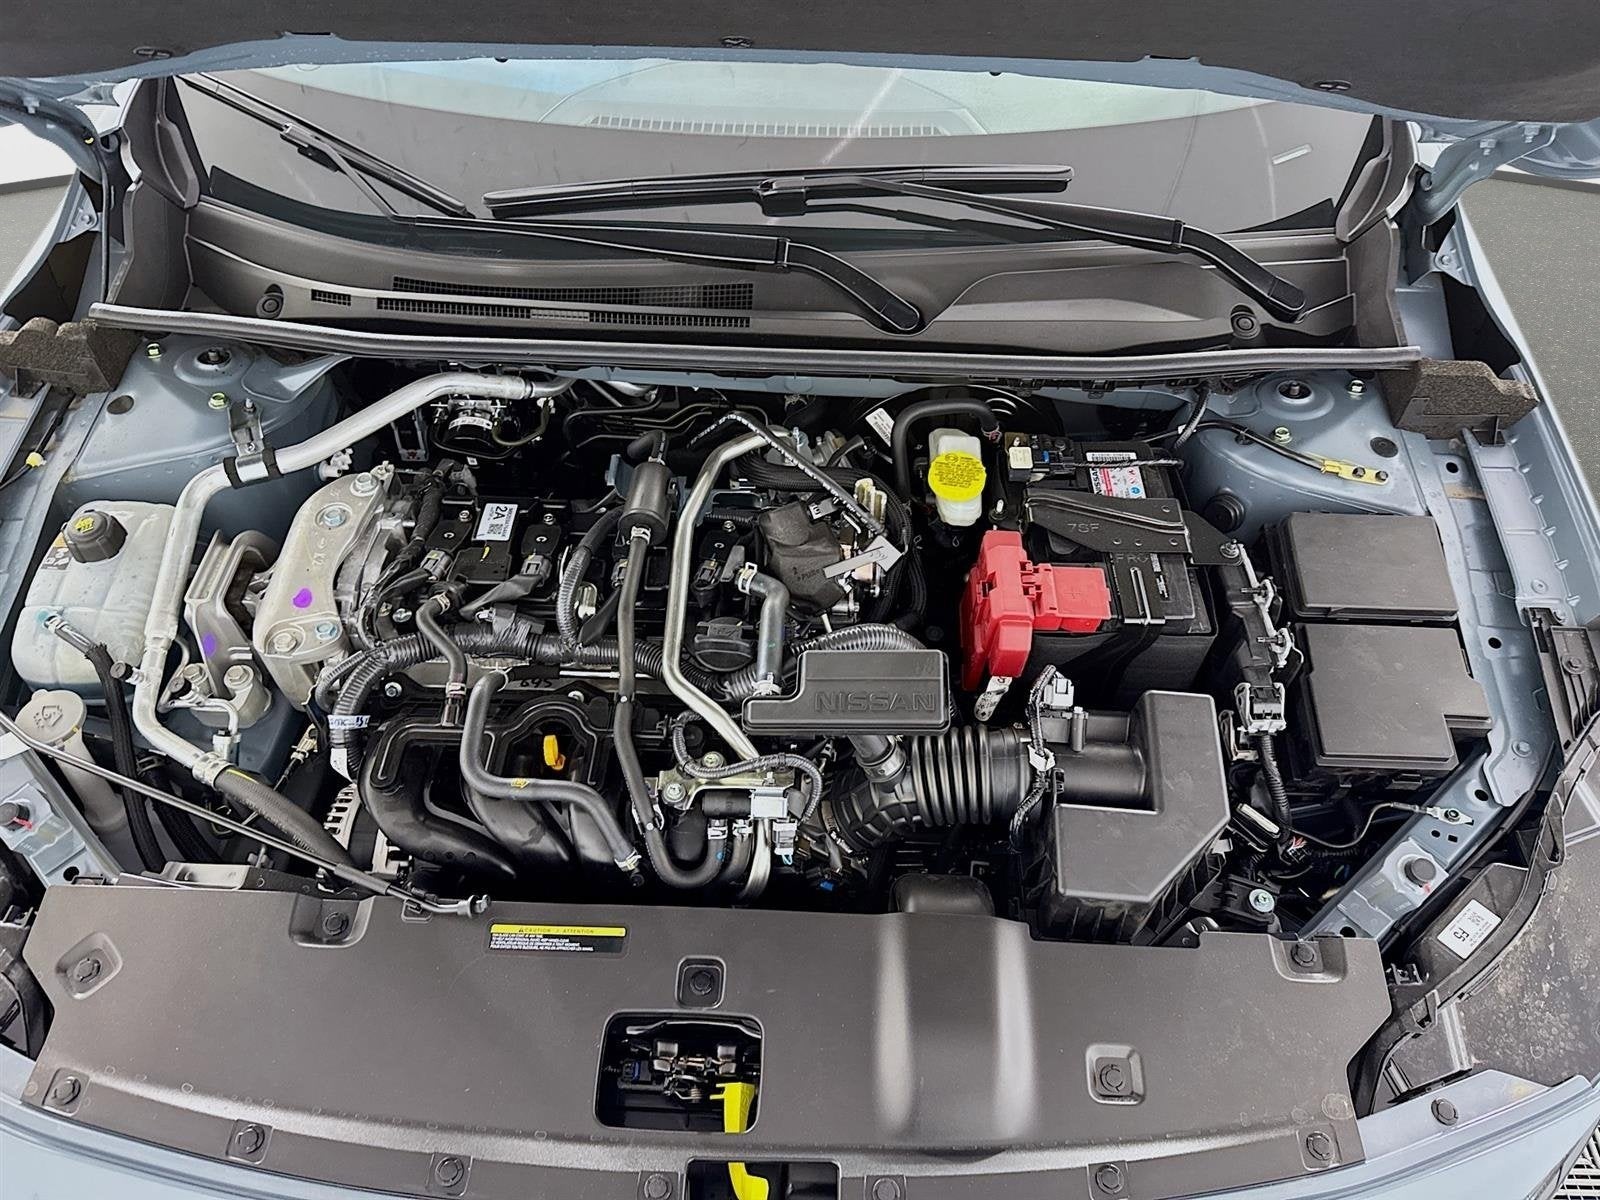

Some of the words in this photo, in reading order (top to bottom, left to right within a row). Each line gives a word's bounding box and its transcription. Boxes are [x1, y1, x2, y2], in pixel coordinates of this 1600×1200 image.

[493, 505, 508, 520] 2A
[814, 692, 935, 712] NISSAN
[1453, 927, 1470, 942] F5
